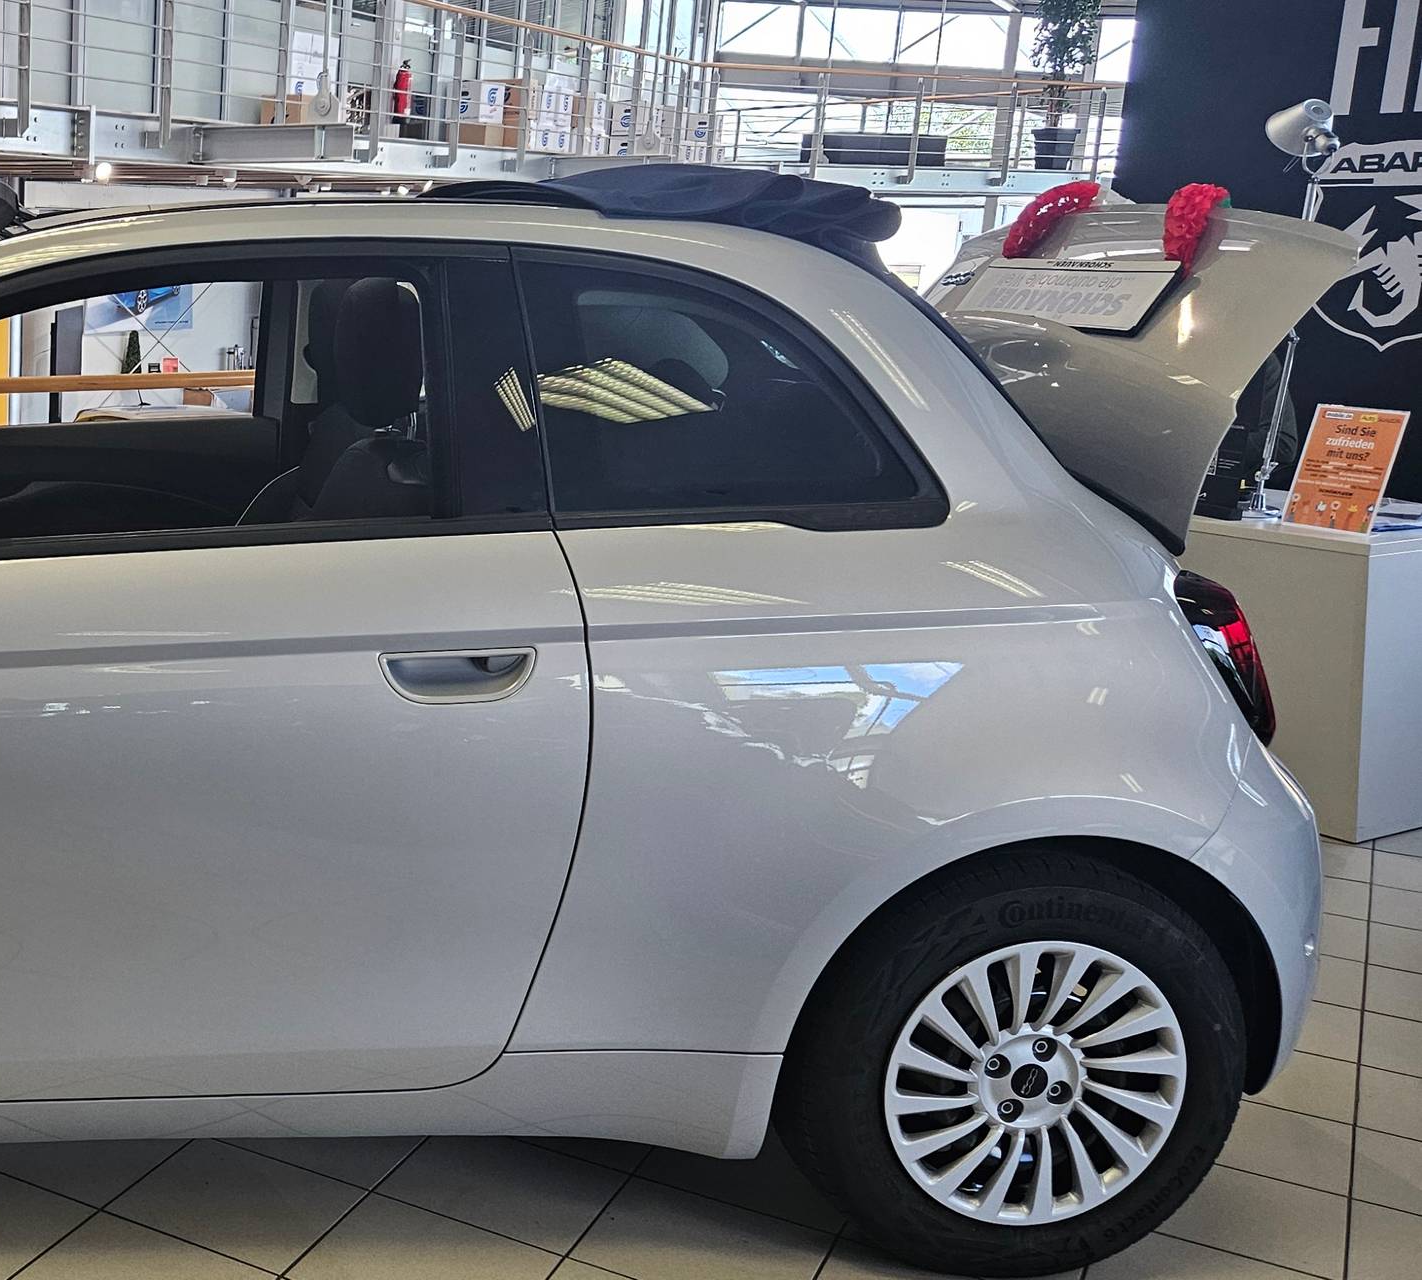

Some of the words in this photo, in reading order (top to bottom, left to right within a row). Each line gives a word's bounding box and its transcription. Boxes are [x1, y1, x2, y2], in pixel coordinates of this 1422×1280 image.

[1329, 0, 1422, 116] FI
[979, 287, 1132, 320] SCHÖNAUEN
[1335, 424, 1358, 436] Sind
[1359, 427, 1377, 437] Sie
[1325, 437, 1375, 449] zufrieden
[1326, 448, 1343, 459] mit
[1345, 451, 1370, 461] uns?
